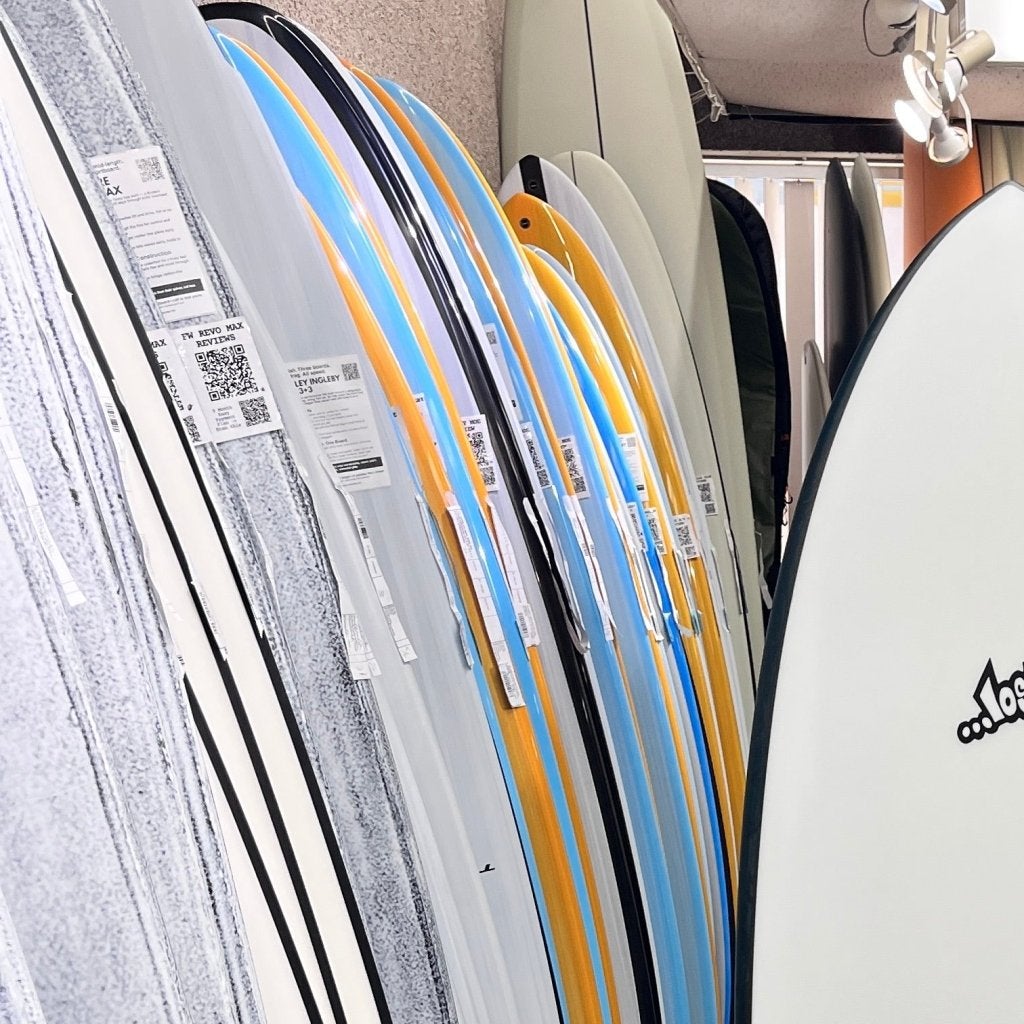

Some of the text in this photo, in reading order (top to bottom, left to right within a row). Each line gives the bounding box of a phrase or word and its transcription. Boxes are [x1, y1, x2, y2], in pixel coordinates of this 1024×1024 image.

[181, 321, 244, 340] FW REVO MAX
[196, 334, 236, 347] REVIEWS
[309, 374, 340, 385] INGLEBY
